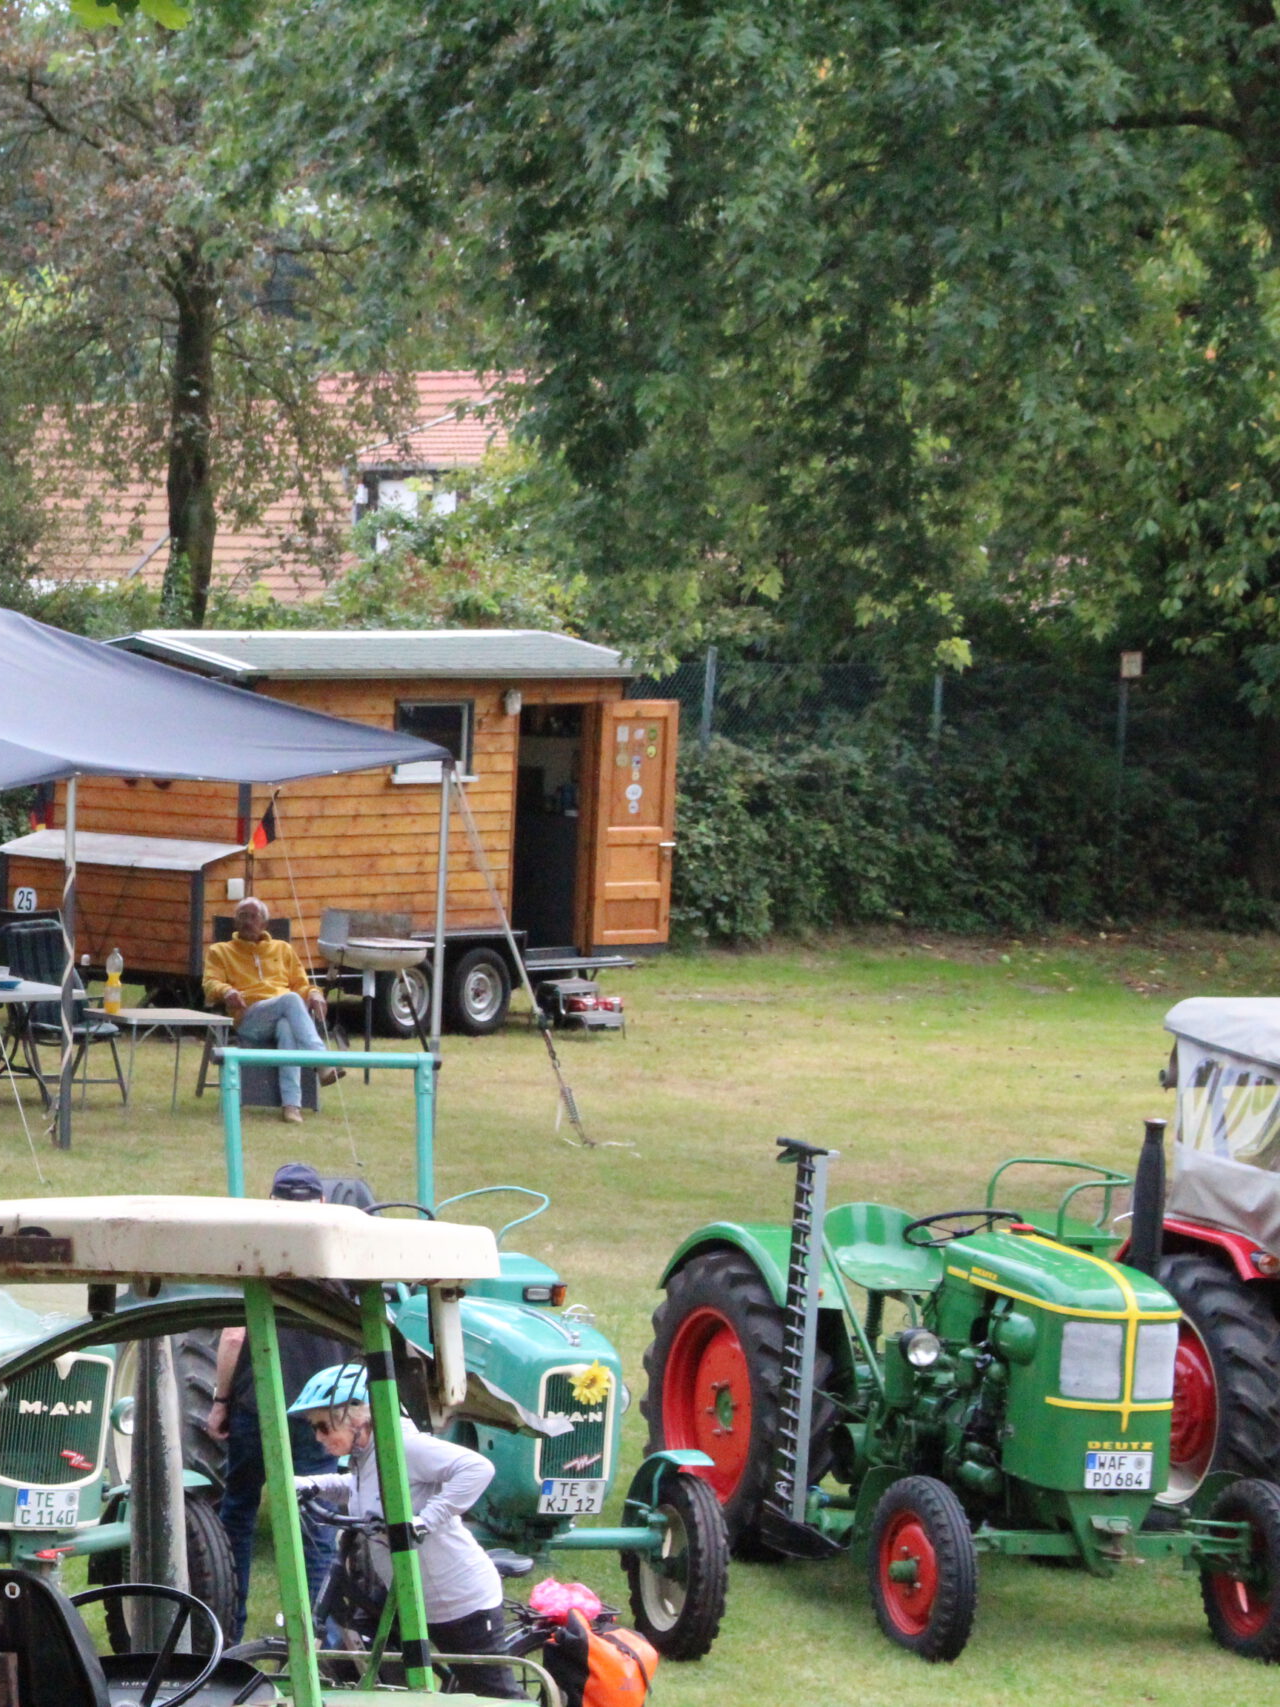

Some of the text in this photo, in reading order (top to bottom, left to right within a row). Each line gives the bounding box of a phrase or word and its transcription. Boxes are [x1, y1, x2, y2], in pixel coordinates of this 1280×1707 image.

[17, 890, 33, 911] 25
[1087, 1441, 1153, 1450] DEUTZ
[1098, 1456, 1127, 1470] WAF
[1115, 1472, 1144, 1487] 684
[560, 1483, 579, 1497] TE
[36, 1492, 54, 1508] TE
[545, 1499, 595, 1512] KJ 12
[21, 1510, 74, 1525] C 1140
